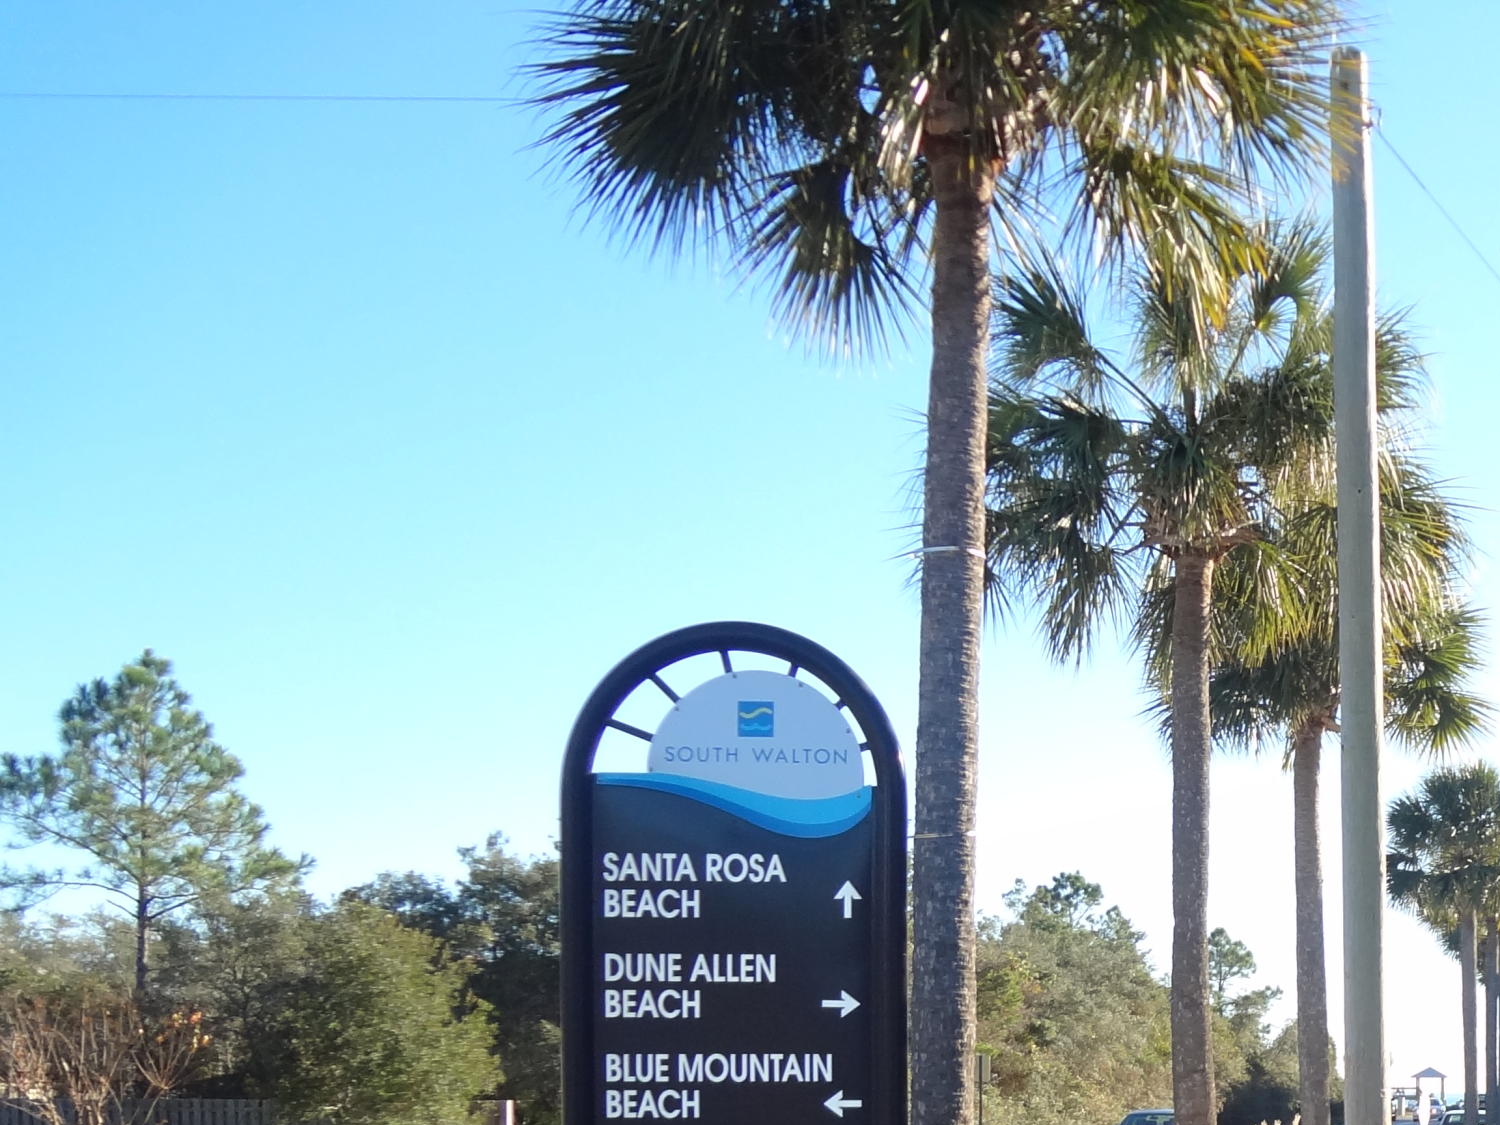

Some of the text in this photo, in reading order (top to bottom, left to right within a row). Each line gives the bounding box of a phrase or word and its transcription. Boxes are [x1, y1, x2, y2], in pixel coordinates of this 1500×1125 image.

[664, 746, 848, 764] SOUTH WALTON
[602, 852, 788, 883] SANTA ROSA
[603, 889, 701, 919] BEACH
[604, 953, 777, 983] DUNE ALLEN
[604, 989, 701, 1019] BEACH
[605, 1053, 833, 1083] BLUE MOUNTAIN
[605, 1089, 700, 1119] BEACH
